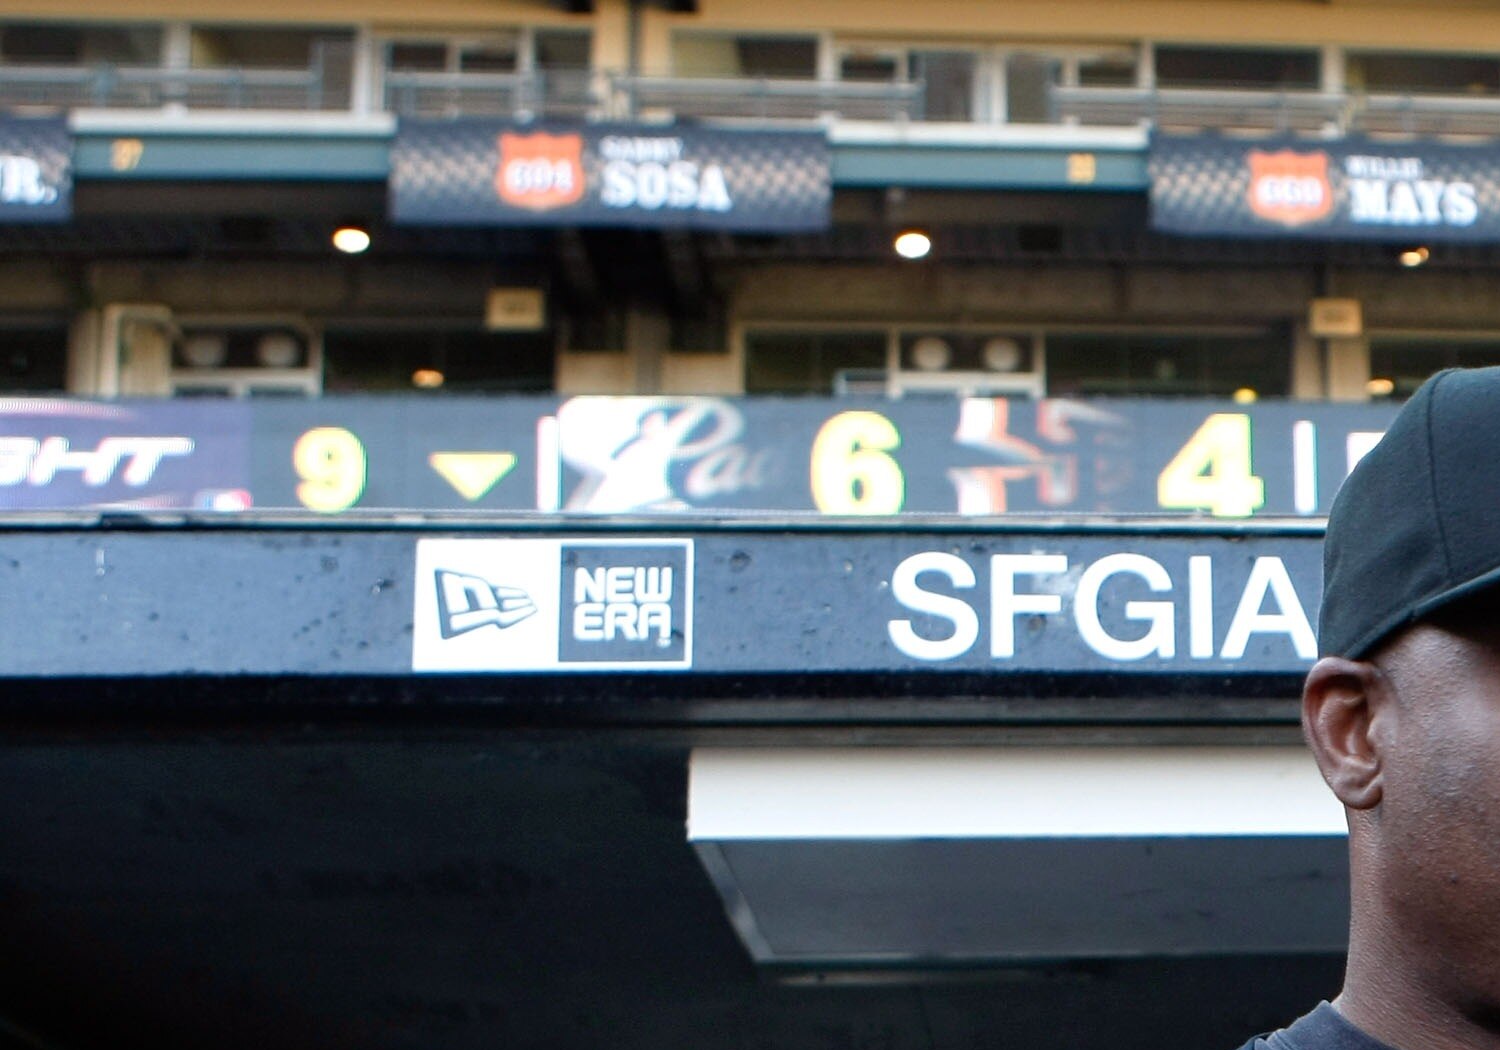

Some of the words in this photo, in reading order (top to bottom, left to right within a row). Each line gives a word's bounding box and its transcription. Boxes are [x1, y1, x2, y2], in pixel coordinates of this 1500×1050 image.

[603, 160, 732, 212] SOSA
[1351, 179, 1478, 226] MAYS
[293, 426, 367, 514] 9
[810, 410, 904, 516] 6
[1158, 413, 1264, 517] 4
[573, 566, 672, 603] NEW
[887, 551, 1319, 661] SFGIA
[573, 602, 671, 640] ERA
